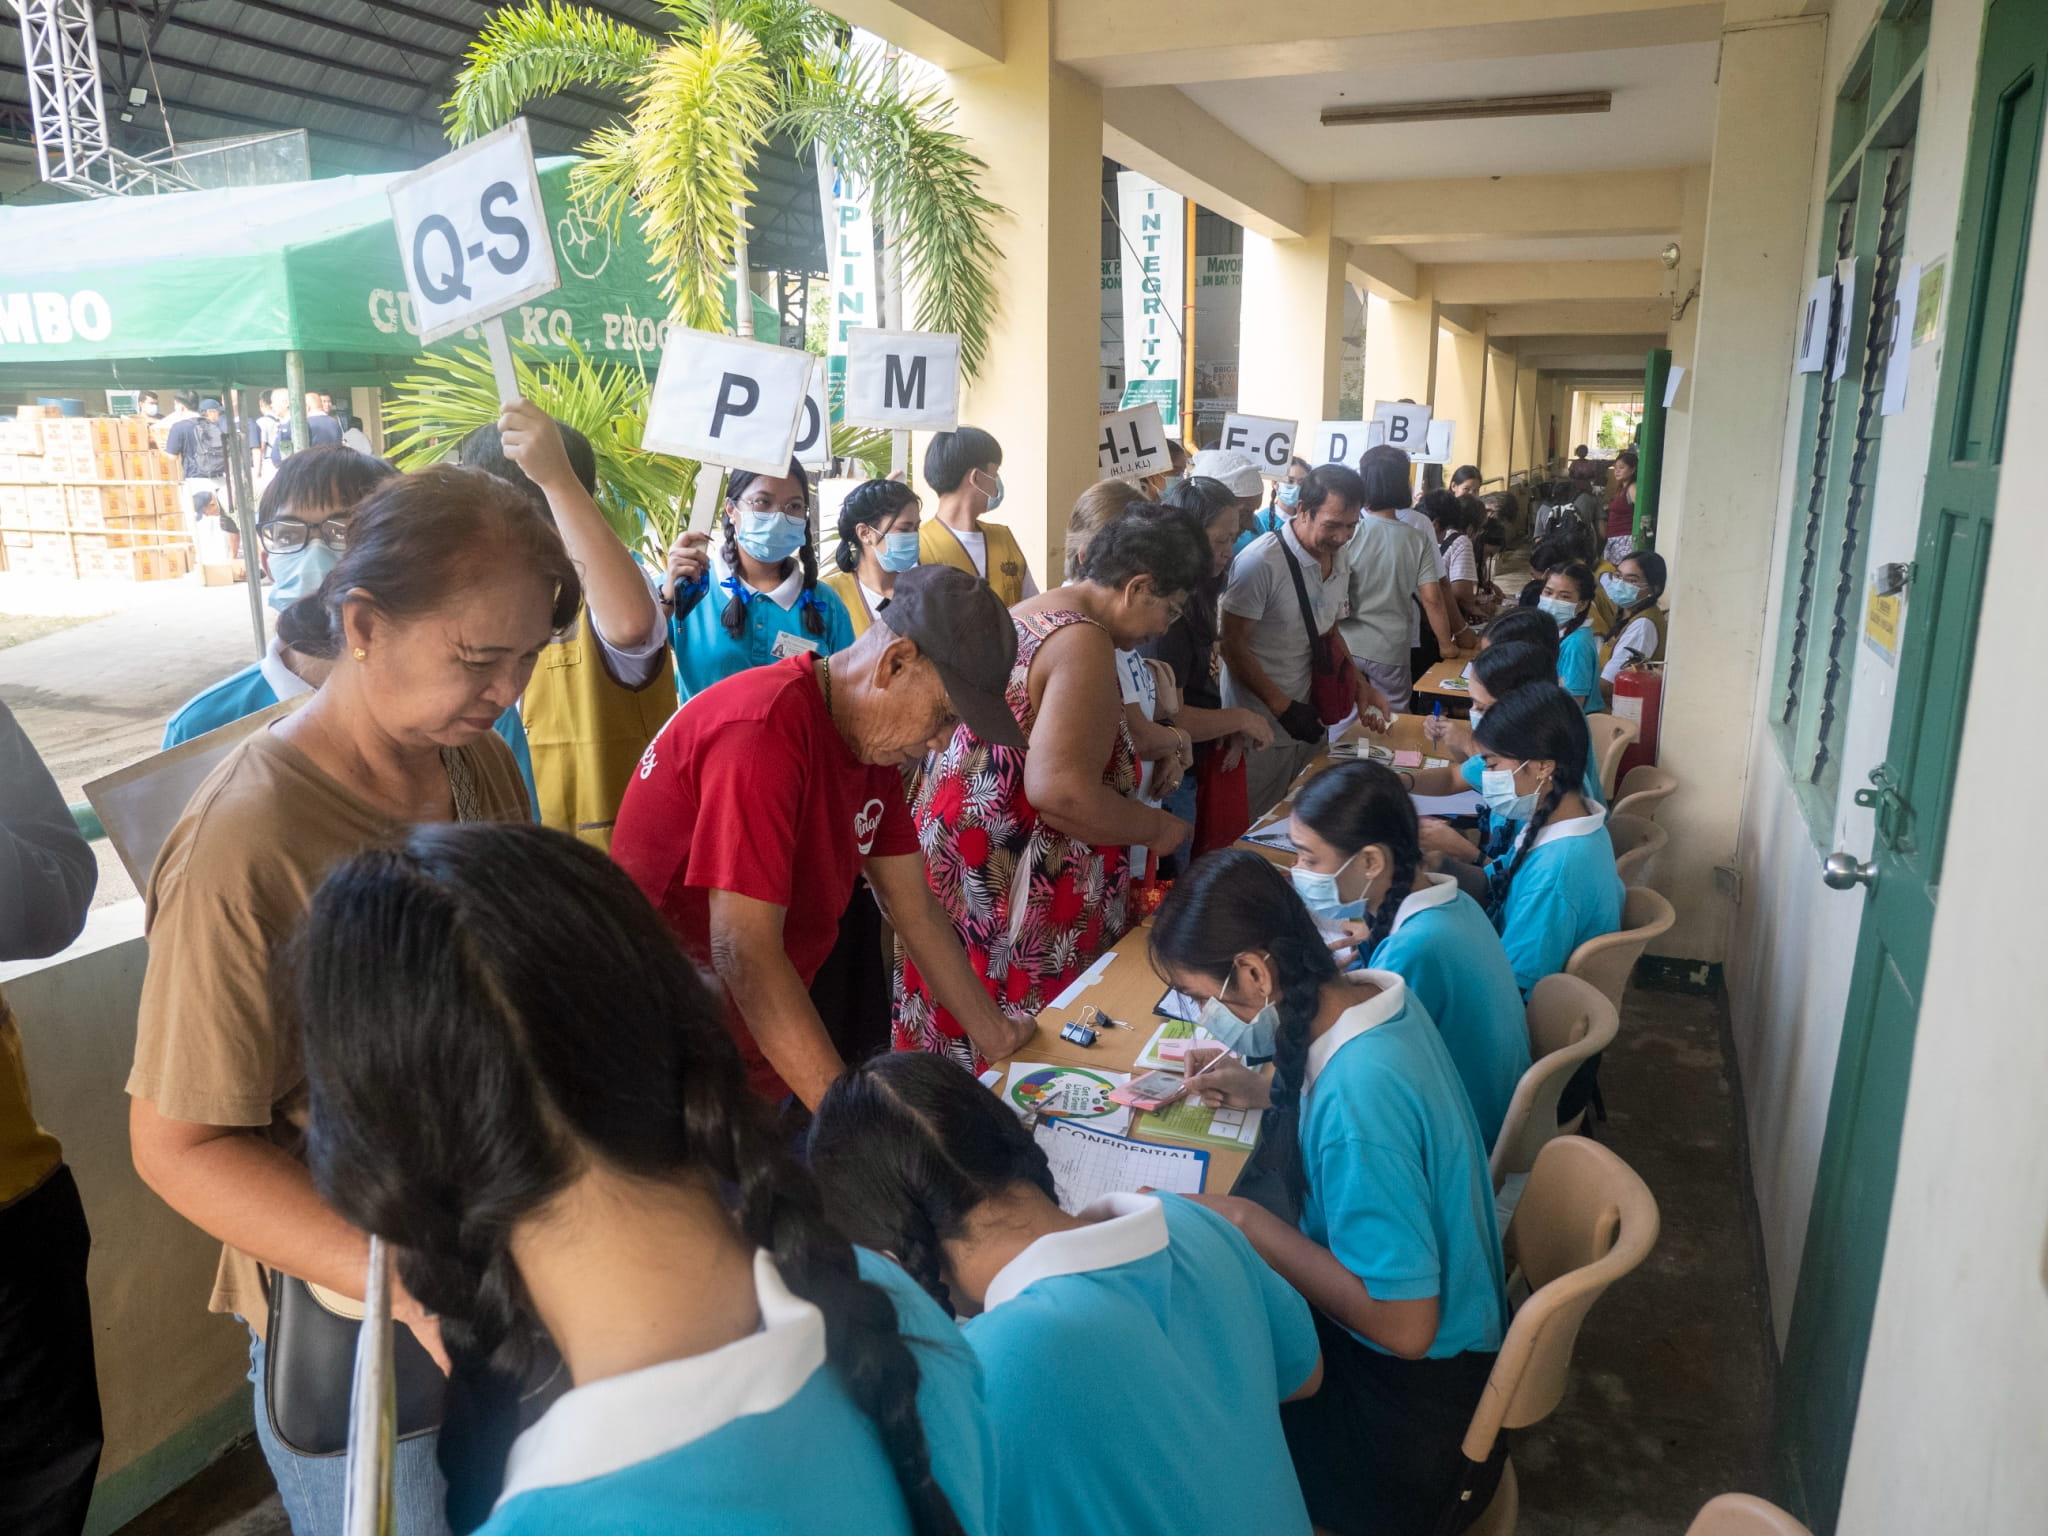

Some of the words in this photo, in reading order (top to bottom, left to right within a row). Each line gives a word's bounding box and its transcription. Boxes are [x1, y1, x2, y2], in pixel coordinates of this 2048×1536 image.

[413, 180, 531, 305] Q-S
[1141, 192, 1161, 376] INTEGRITY
[709, 371, 760, 438] P
[883, 354, 927, 410] M
[1328, 432, 1348, 463] D
[1389, 415, 1409, 442] B
